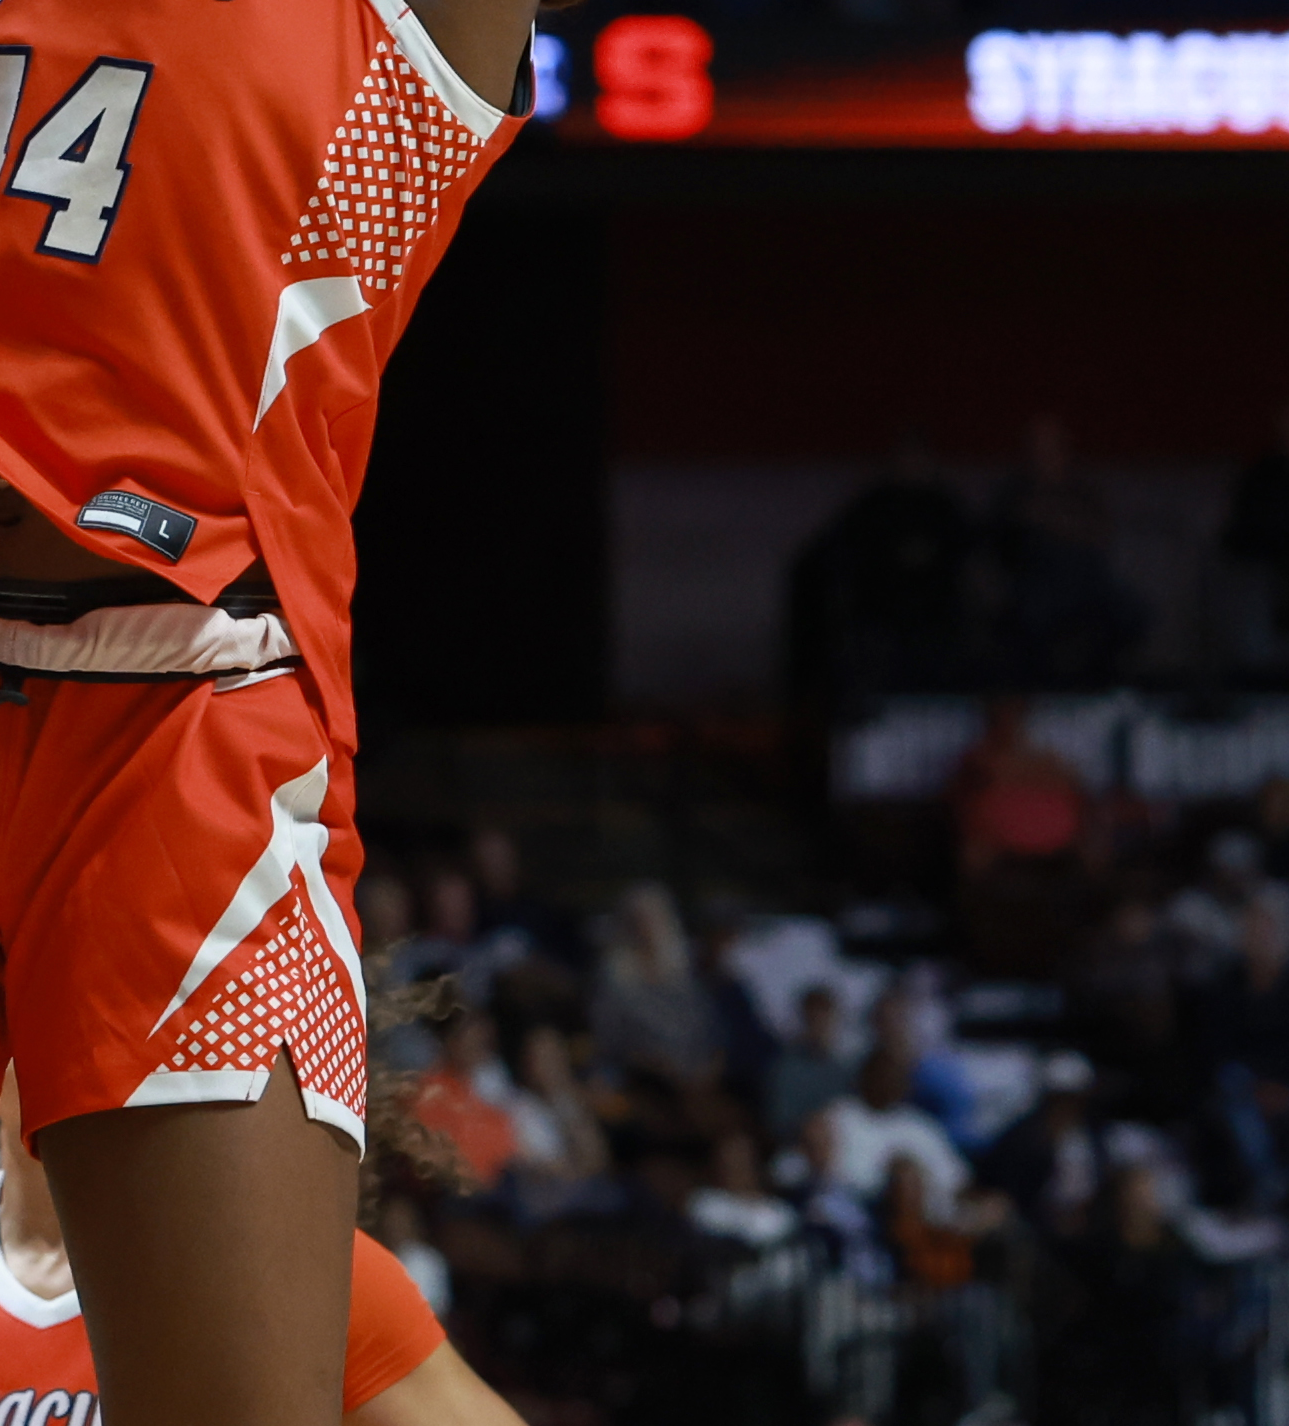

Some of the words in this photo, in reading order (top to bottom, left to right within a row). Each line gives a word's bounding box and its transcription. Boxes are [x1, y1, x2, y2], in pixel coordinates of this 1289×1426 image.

[593, 13, 715, 142] S
[965, 27, 1289, 136] SYRACU
[158, 519, 170, 540] L
